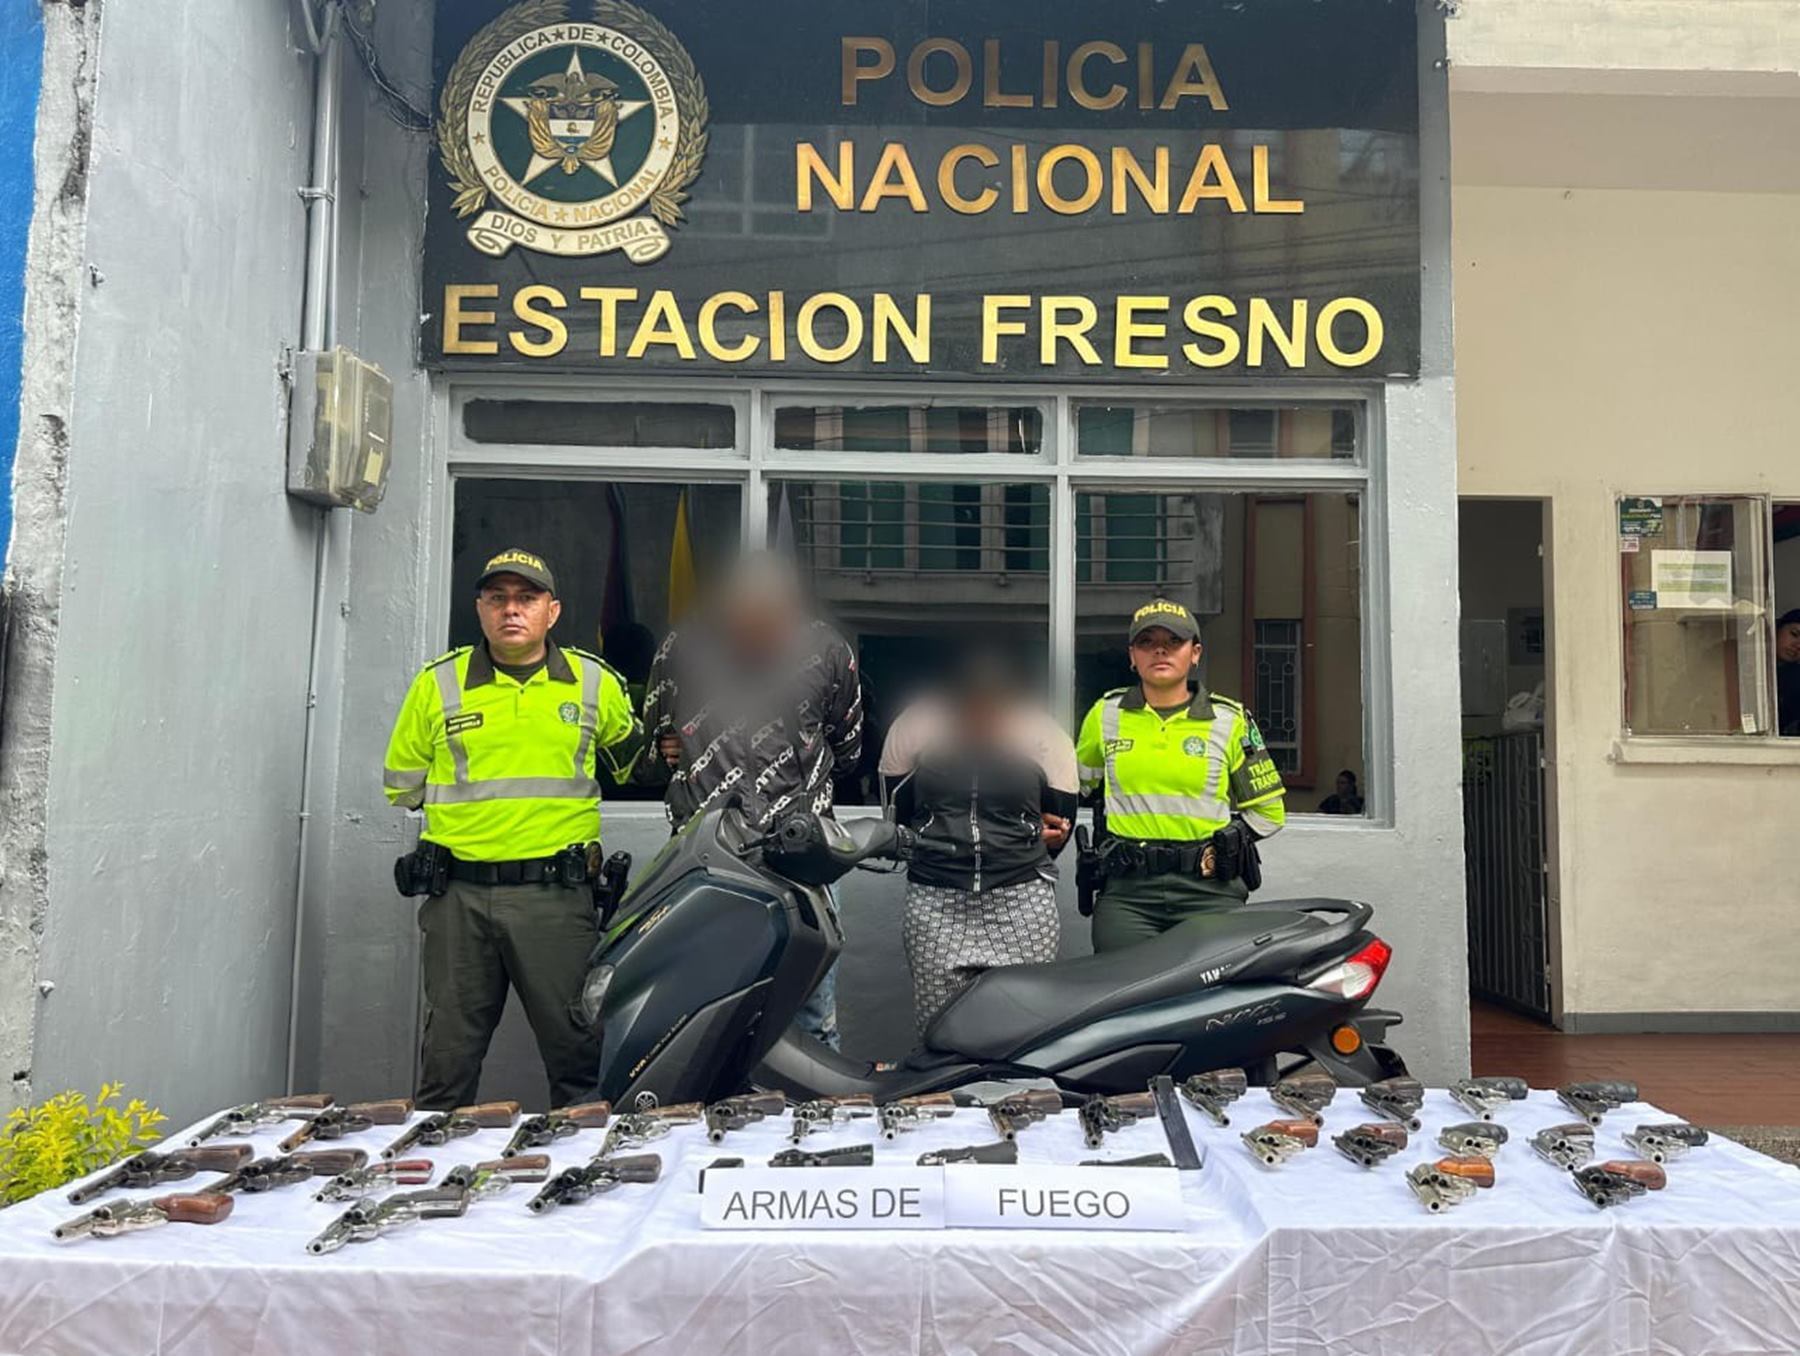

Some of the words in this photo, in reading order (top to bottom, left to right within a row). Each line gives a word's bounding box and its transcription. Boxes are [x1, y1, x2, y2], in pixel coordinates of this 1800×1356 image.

[472, 31, 551, 114] REPUBLICA
[567, 25, 595, 41] DE
[610, 37, 675, 119] COLOMBIA
[841, 36, 1230, 111] POLICIA
[483, 165, 549, 220] POLICIA
[574, 168, 662, 222] NACIONAL
[796, 140, 1305, 214] NACIONAL
[490, 214, 538, 244] DIOS
[550, 234, 566, 250] Y
[577, 223, 649, 251] PATRIA
[443, 284, 930, 363] ESTACION
[982, 294, 1385, 368] FRESNO
[485, 551, 544, 572] POLICIA
[1134, 602, 1187, 622] POLICIA
[723, 1188, 859, 1220] ARMAS
[871, 1187, 921, 1218] DE
[998, 1188, 1130, 1218] FUEGO
